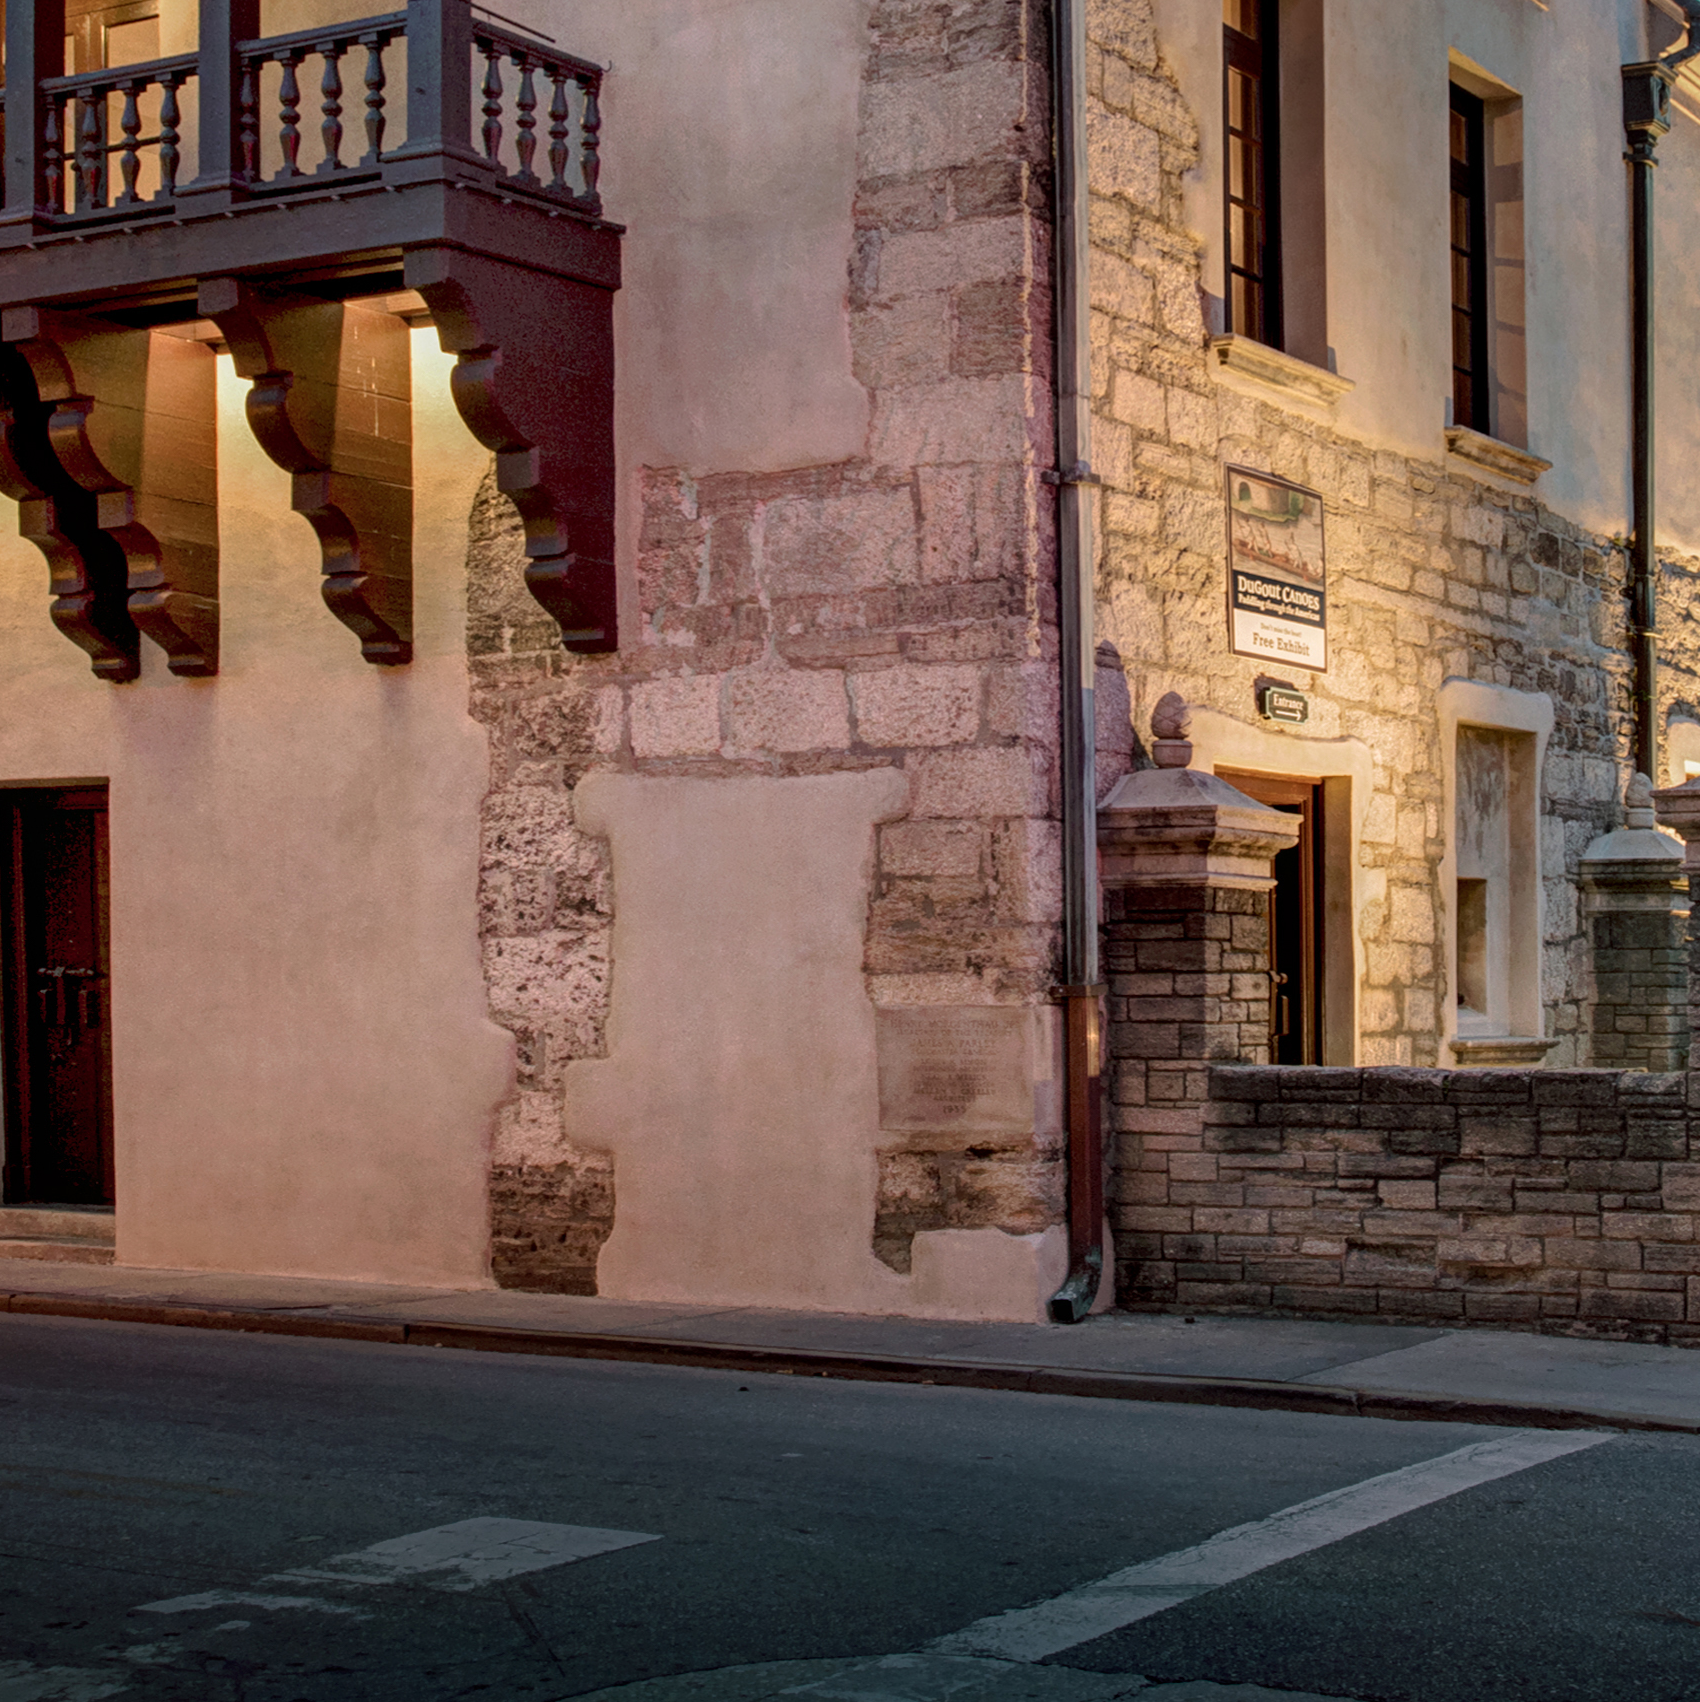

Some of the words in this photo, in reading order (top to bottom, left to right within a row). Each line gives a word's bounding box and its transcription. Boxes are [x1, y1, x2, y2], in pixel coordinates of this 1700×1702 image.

[1253, 632, 1275, 649] Free
[1277, 637, 1310, 657] Exhibit
[1273, 693, 1304, 711] Entrance
